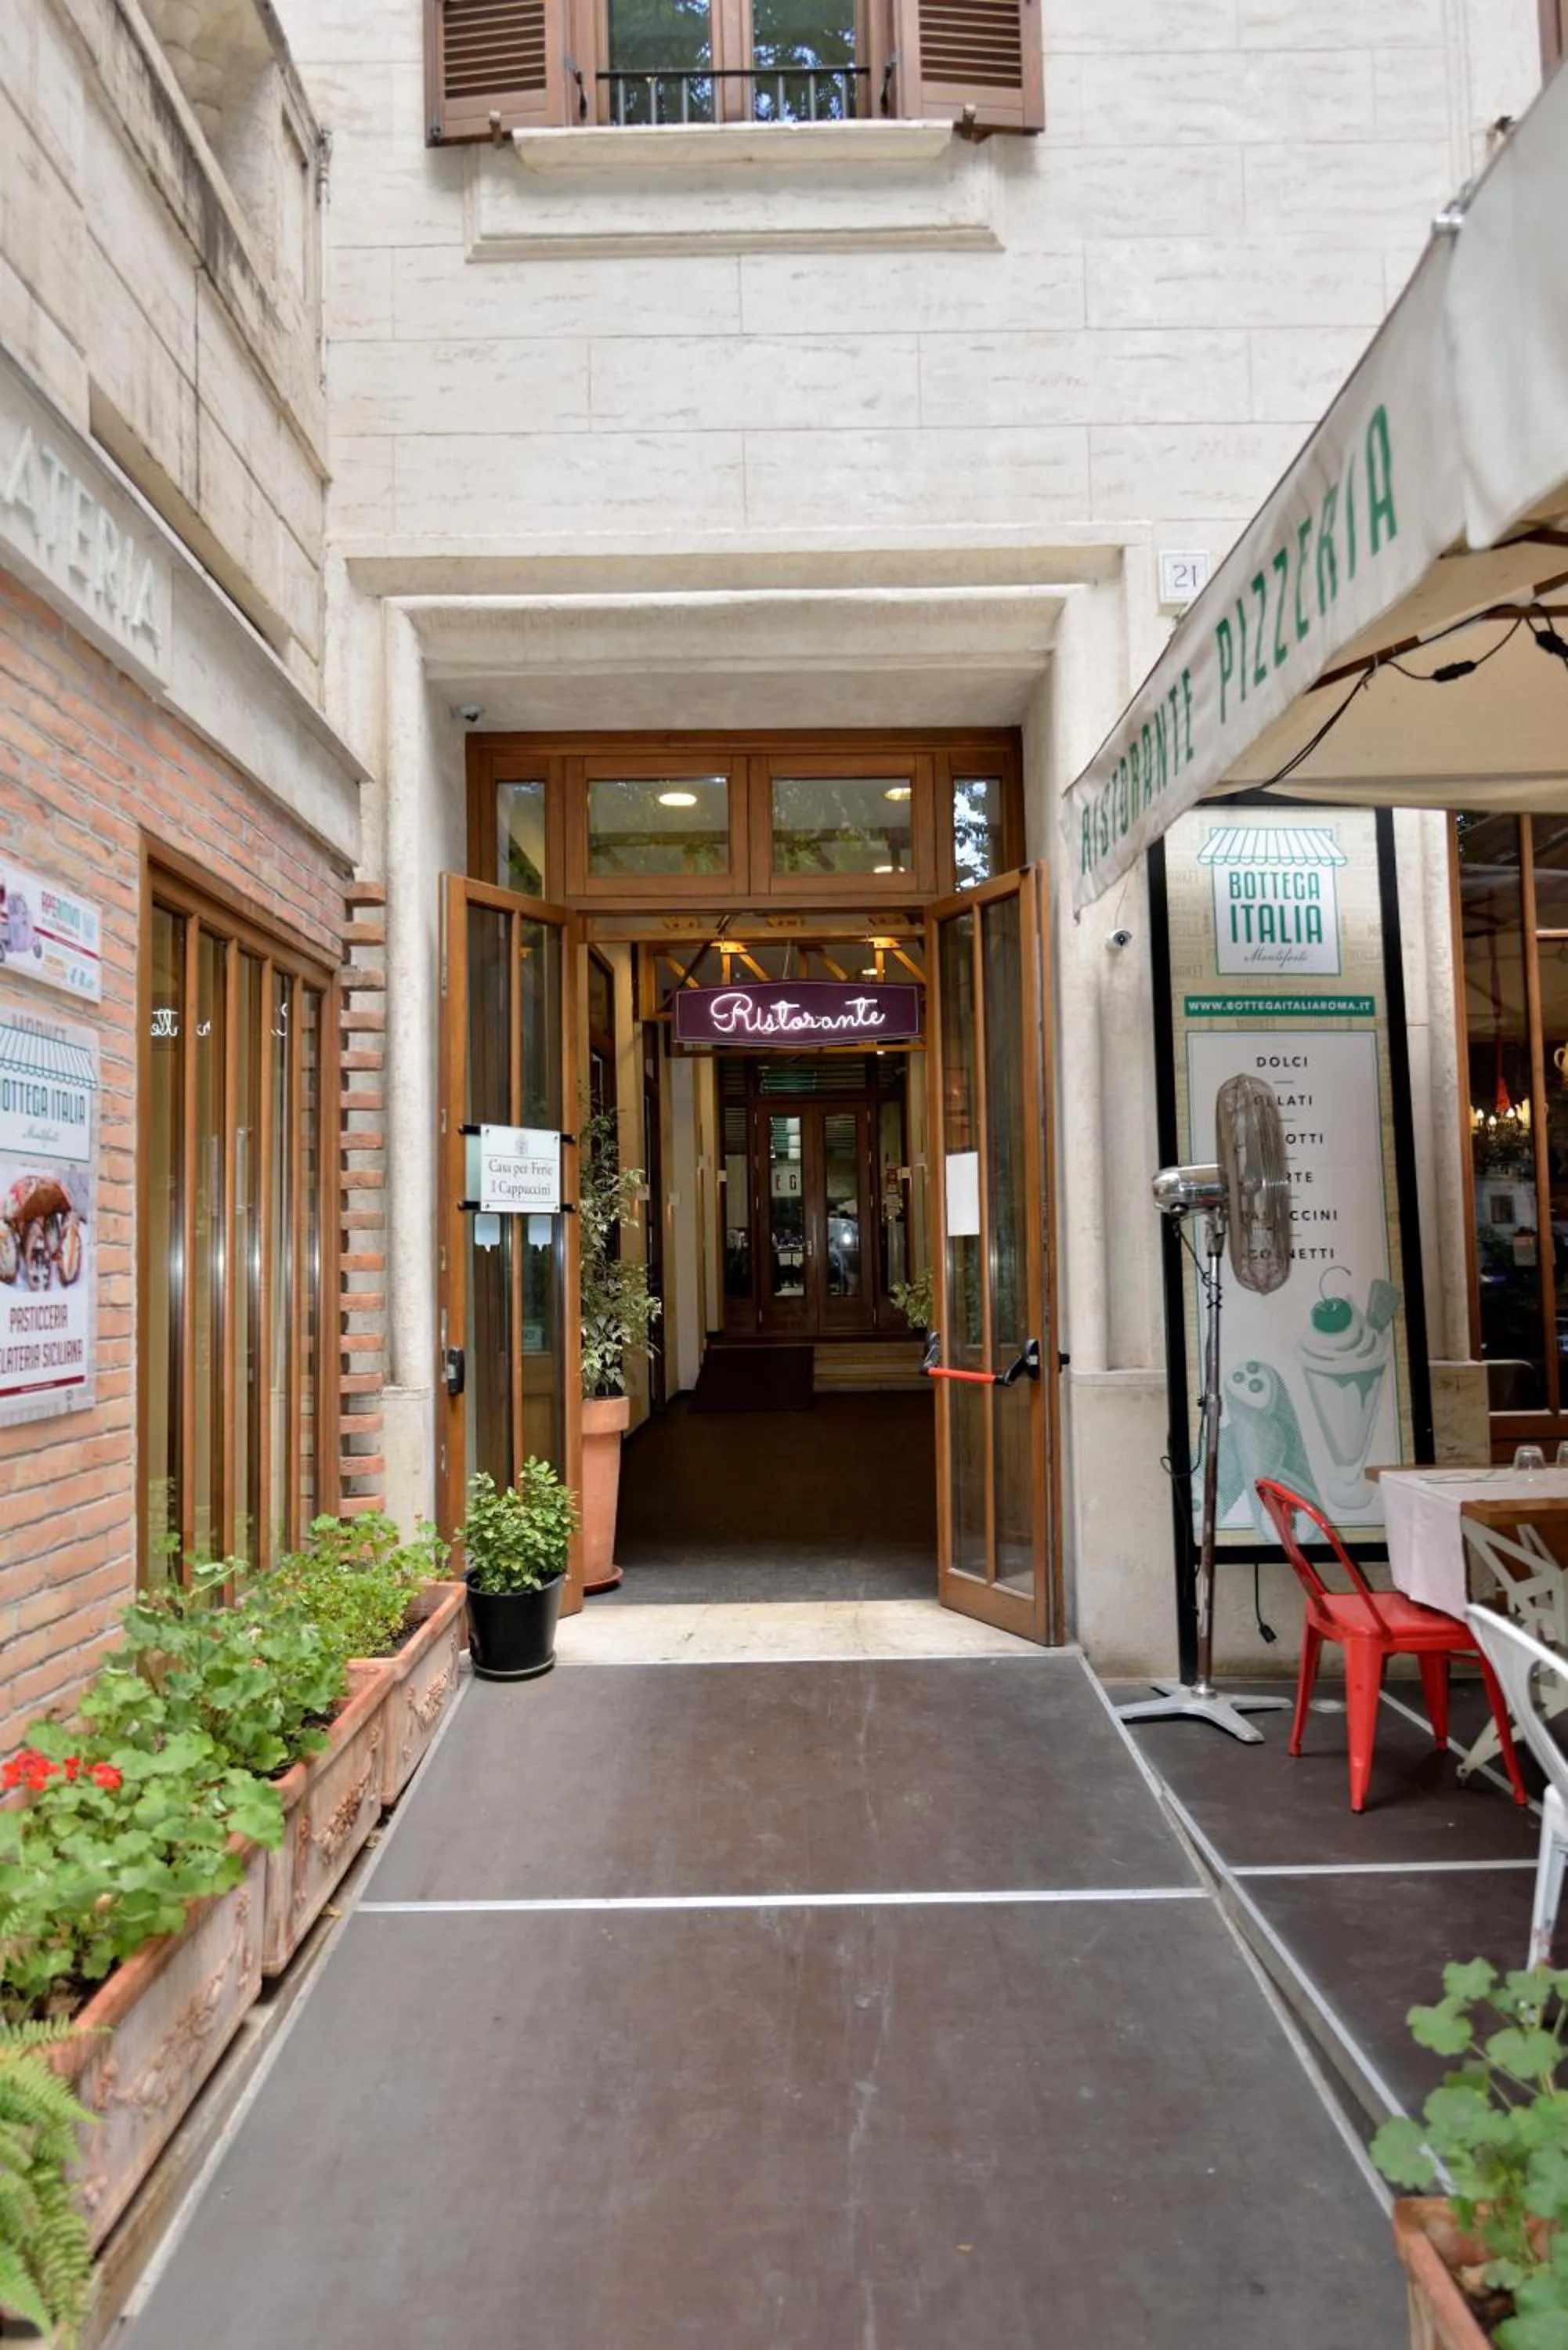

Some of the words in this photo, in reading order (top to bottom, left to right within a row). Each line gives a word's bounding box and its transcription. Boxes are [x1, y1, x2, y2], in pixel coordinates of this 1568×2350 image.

[1172, 564, 1197, 588] 21
[1081, 669, 1194, 876] RISTORANTE
[1216, 403, 1398, 725] PIZZERIA
[1229, 871, 1321, 900] BOTTEGA
[1230, 904, 1324, 945] ITALIA
[710, 992, 886, 1034] Ristorante
[1187, 1000, 1371, 1011] WWW.BOTTEGAITALIAROMA.IT
[1256, 1057, 1309, 1068] DOLCI
[0, 1078, 48, 1119] OTTEGA
[51, 1088, 85, 1127] ITALIA
[488, 1159, 512, 1173] Casa
[513, 1164, 529, 1179] per
[531, 1161, 553, 1176] Ferie
[498, 1180, 551, 1199] Cappuccini
[9, 1303, 68, 1334] PASTICCERIA
[42, 1338, 83, 1368] SICILIANA
